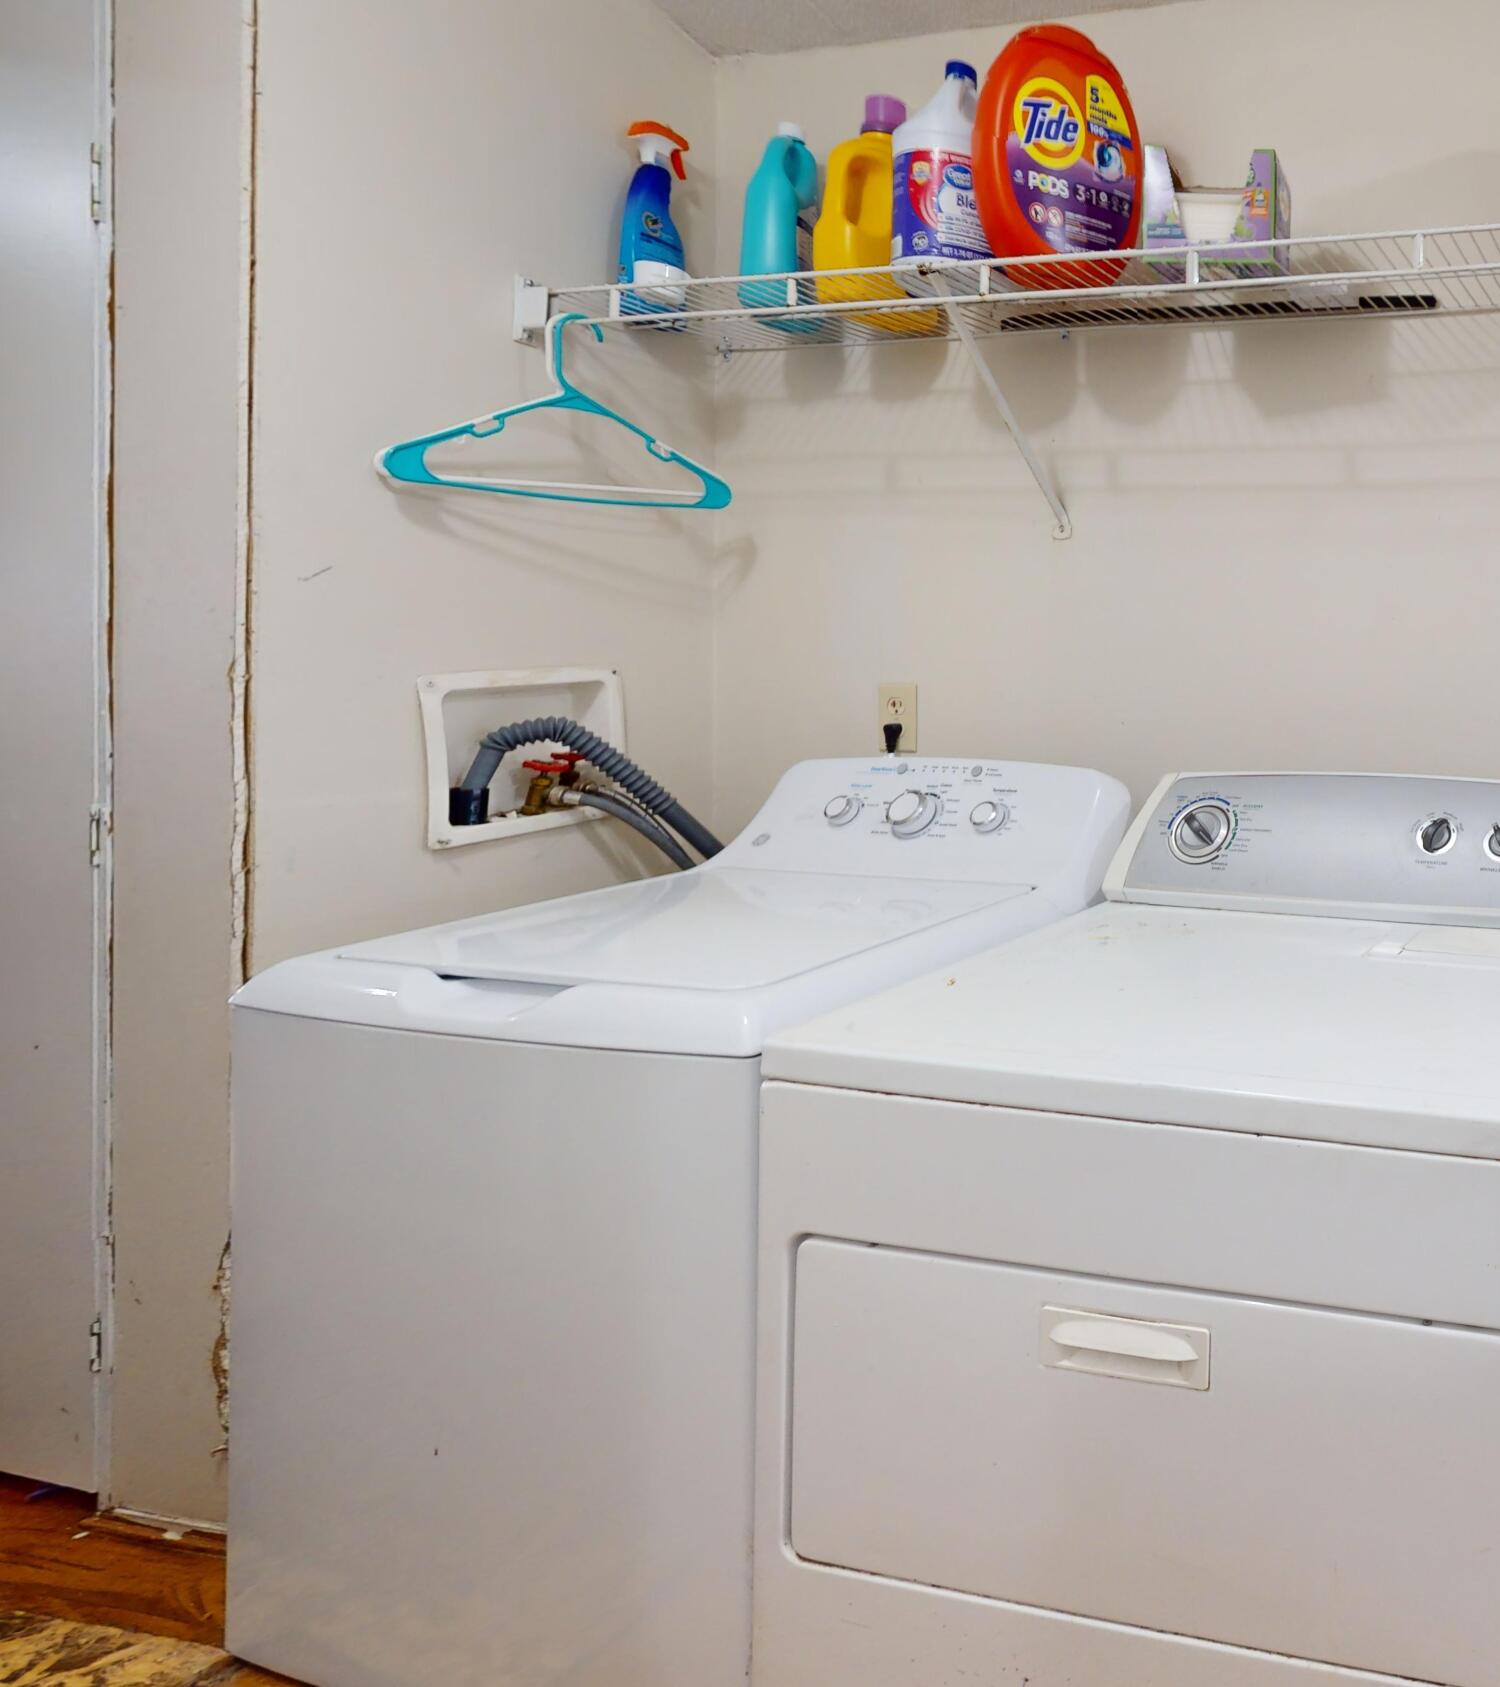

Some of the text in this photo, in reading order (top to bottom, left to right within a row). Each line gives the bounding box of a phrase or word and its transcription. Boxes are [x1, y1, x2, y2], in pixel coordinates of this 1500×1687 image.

[1022, 100, 1079, 145] Tide
[1028, 170, 1069, 199] PODS
[956, 193, 977, 211] Ble
